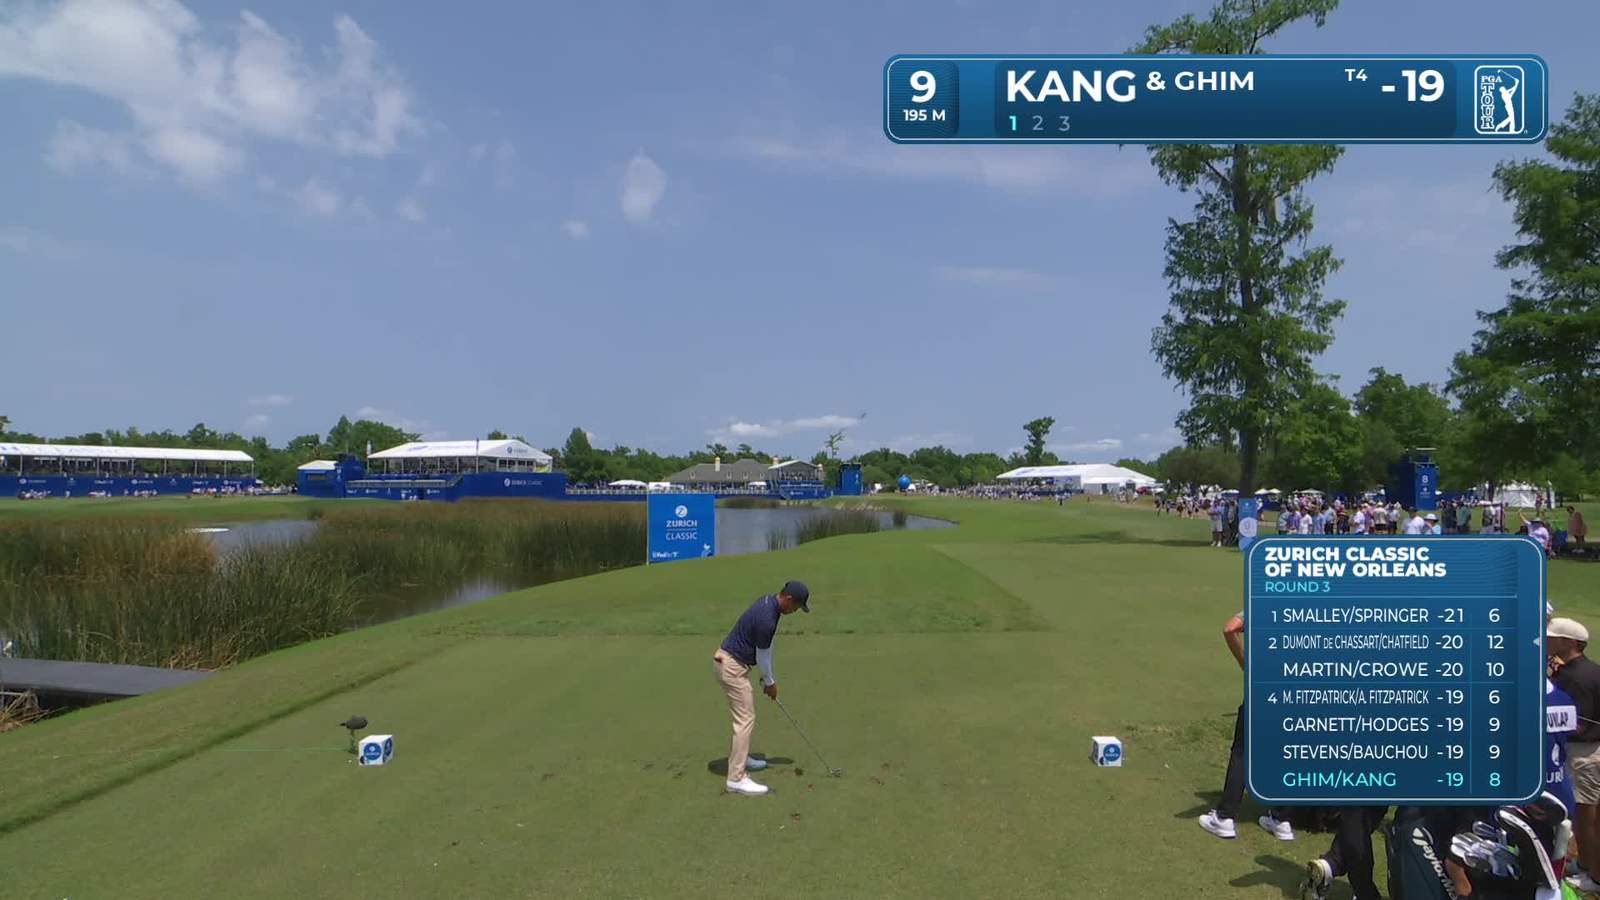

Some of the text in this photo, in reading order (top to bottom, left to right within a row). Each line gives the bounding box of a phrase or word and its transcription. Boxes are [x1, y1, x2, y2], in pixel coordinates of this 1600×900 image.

[665, 519, 698, 528] ZURICH
[665, 531, 698, 541] CLASSIC
[1547, 711, 1569, 729] UNLAP
